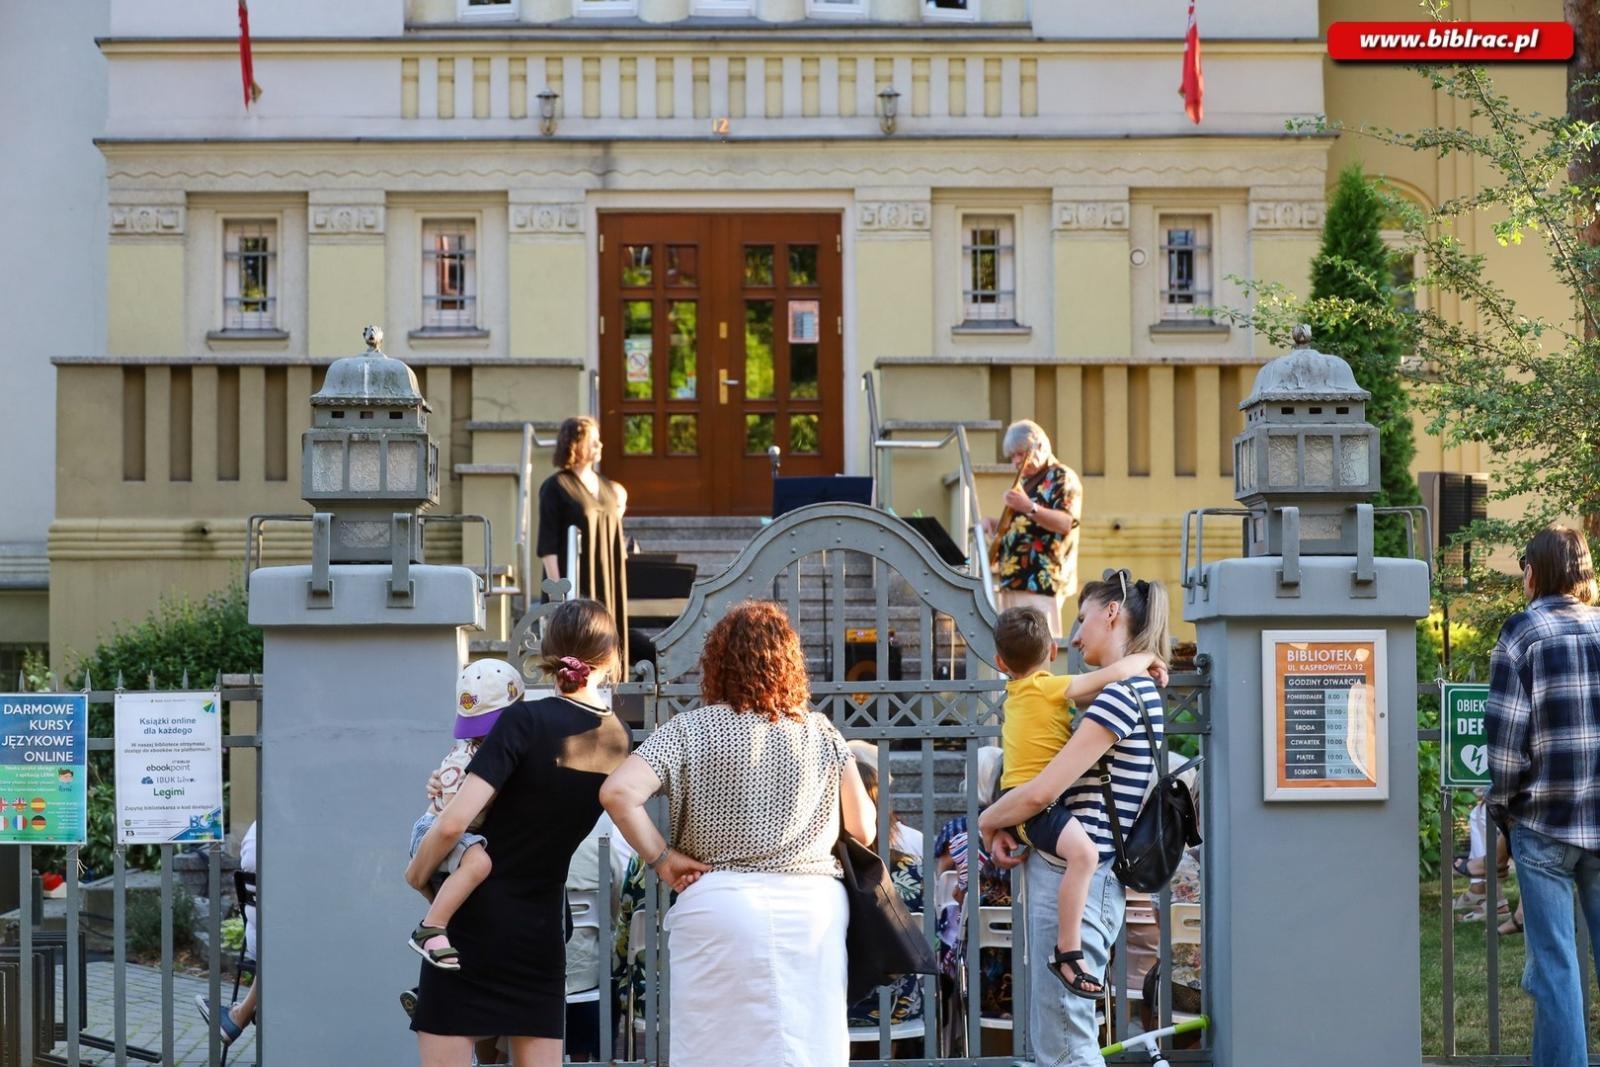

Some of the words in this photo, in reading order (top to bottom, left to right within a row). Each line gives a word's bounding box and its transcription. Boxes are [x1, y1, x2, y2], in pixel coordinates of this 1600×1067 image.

[712, 118, 729, 133] 12
[1300, 663, 1352, 671] KASPROWICZA
[1355, 663, 1363, 671] 12
[1288, 678, 1321, 686] GODZINY
[1323, 678, 1362, 686] OTWARCIA
[3, 704, 74, 715] DARMOWE
[1456, 699, 1488, 712] OBIEK
[29, 720, 74, 731] KURSY
[139, 717, 169, 726] Książki
[171, 717, 197, 725] online
[143, 727, 156, 735] dla
[158, 726, 193, 736] każdego
[1, 735, 74, 750] JĘZYKOWE
[24, 751, 74, 763] ONLINE
[146, 764, 191, 772] ebookpoint
[153, 787, 185, 799] Legimi
